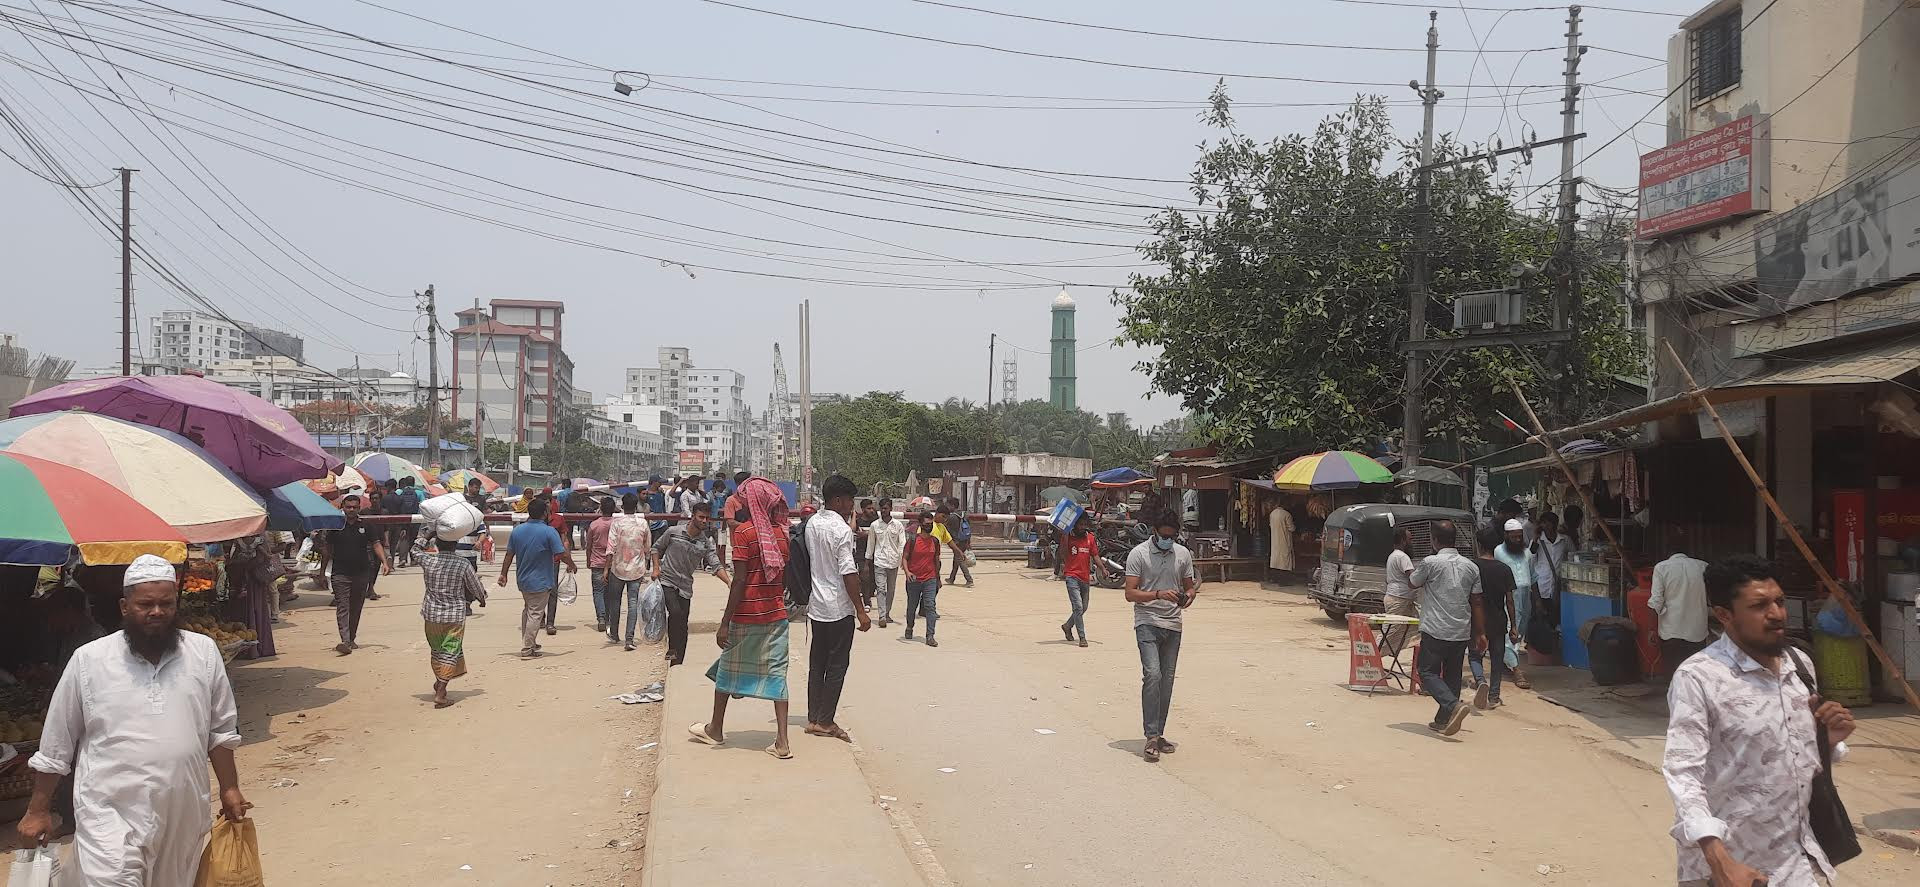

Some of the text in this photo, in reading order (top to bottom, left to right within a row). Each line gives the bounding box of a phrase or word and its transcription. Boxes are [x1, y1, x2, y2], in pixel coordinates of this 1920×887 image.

[1642, 152, 1666, 168] Imperial
[1666, 145, 1688, 160] Money
[1689, 133, 1722, 151] Exchange
[1723, 127, 1735, 138] Co.
